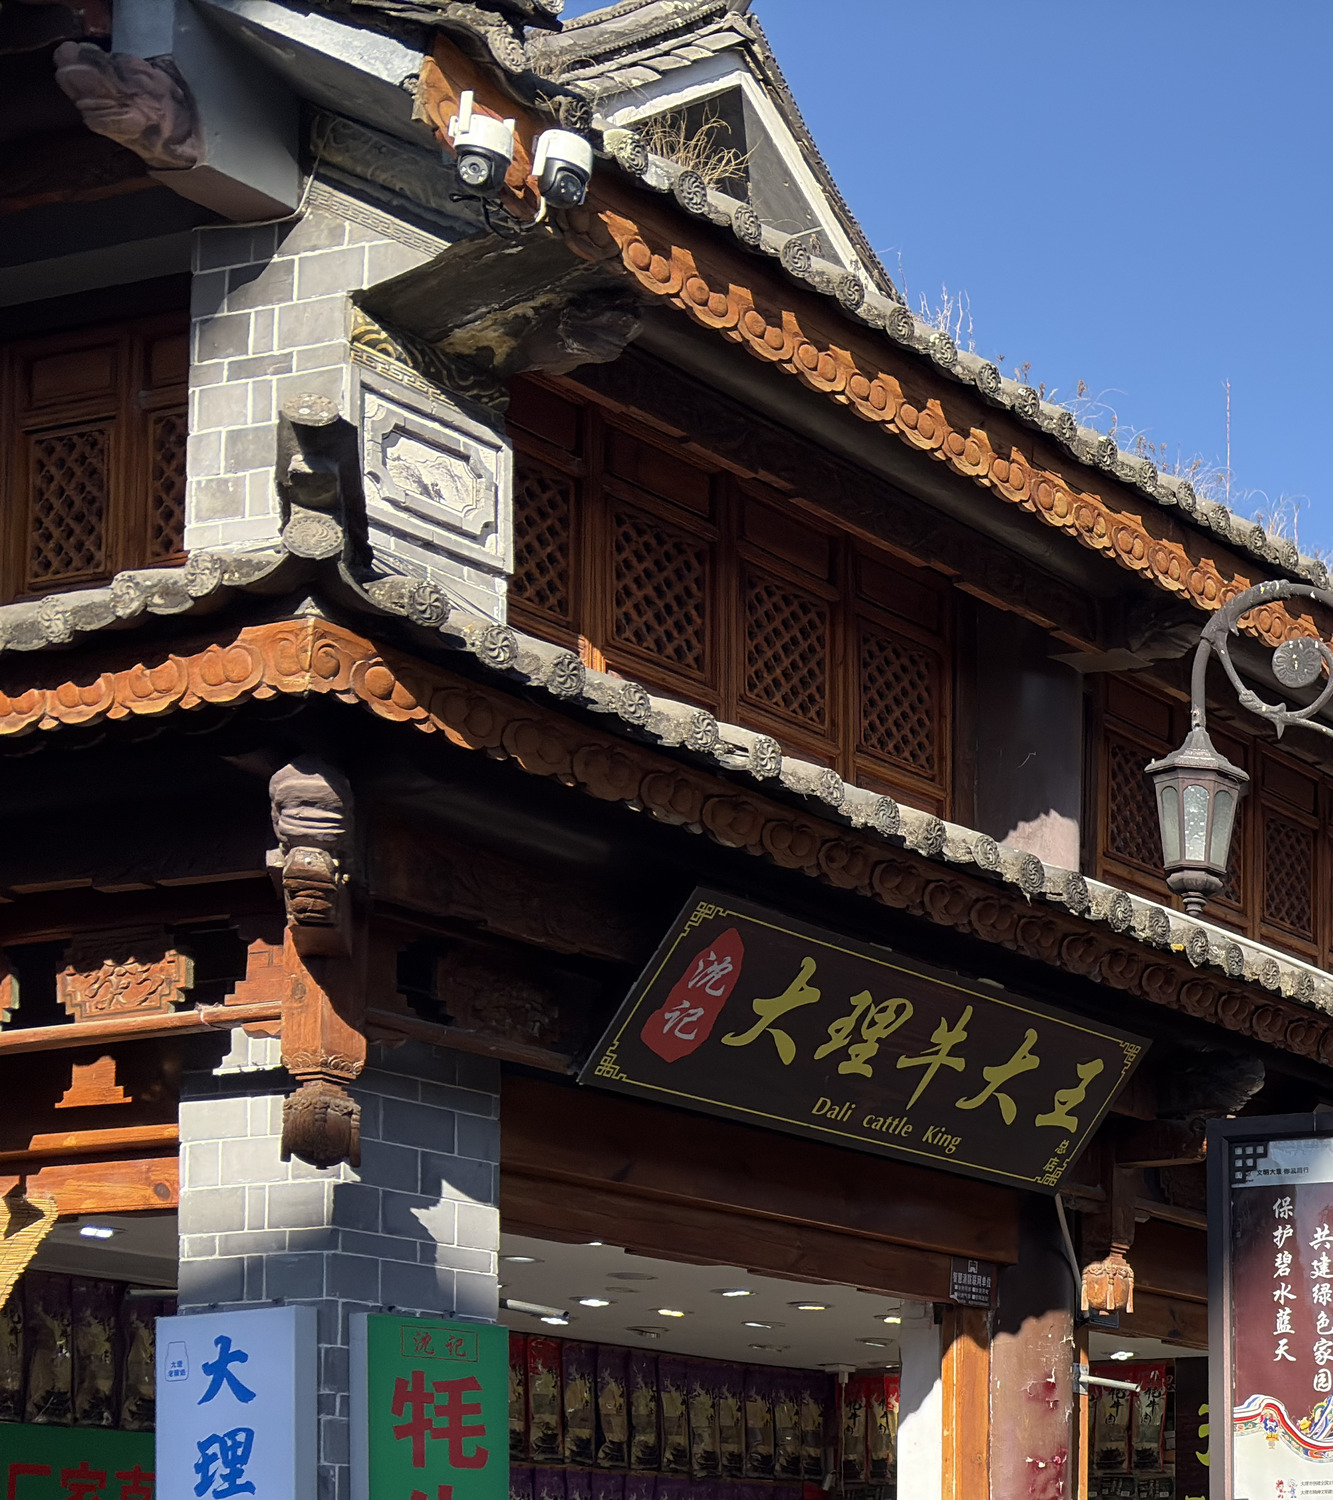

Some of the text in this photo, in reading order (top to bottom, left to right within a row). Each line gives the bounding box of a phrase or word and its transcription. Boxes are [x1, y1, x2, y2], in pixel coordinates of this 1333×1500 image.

[721, 956, 1105, 1134] 大理牛大王
[811, 1096, 963, 1155] Dali cattle King
[1272, 1197, 1297, 1363] 保护碧水蓝天
